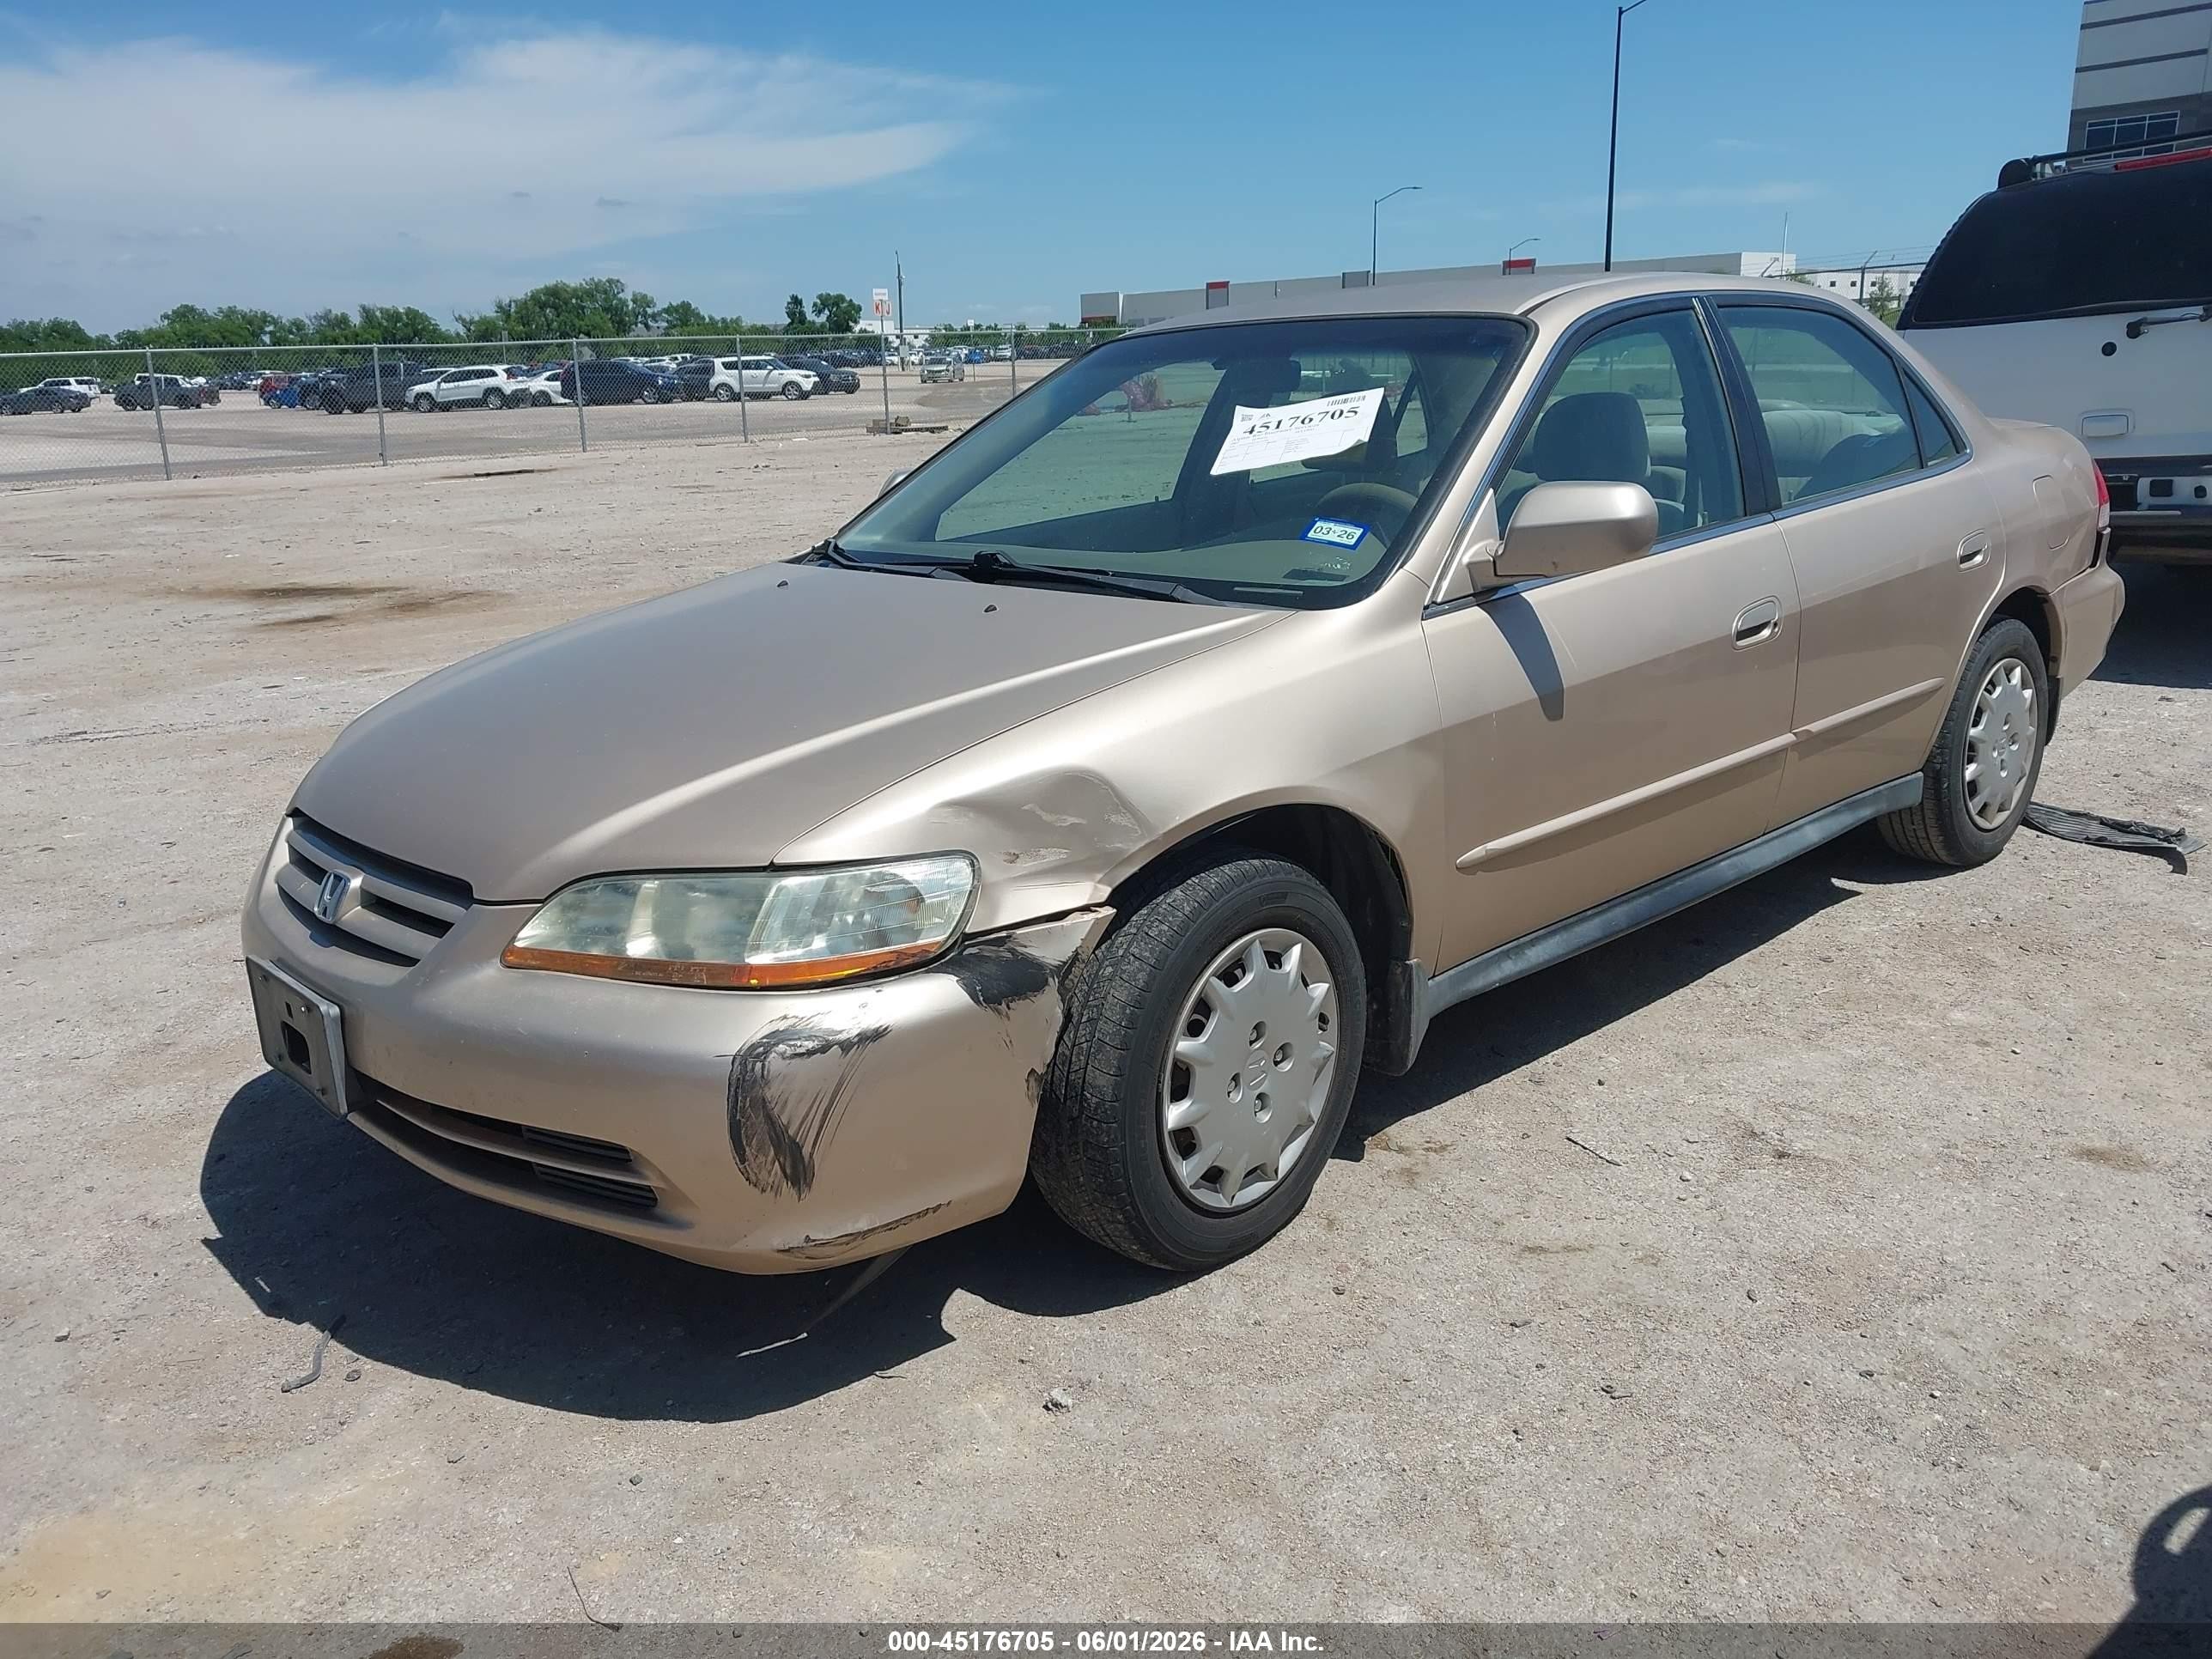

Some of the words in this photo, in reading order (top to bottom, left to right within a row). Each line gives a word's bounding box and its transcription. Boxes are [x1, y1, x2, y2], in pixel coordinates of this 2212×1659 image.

[875, 301, 881, 314] K
[1243, 406, 1360, 434] 45176705
[1336, 529, 1357, 540] 26
